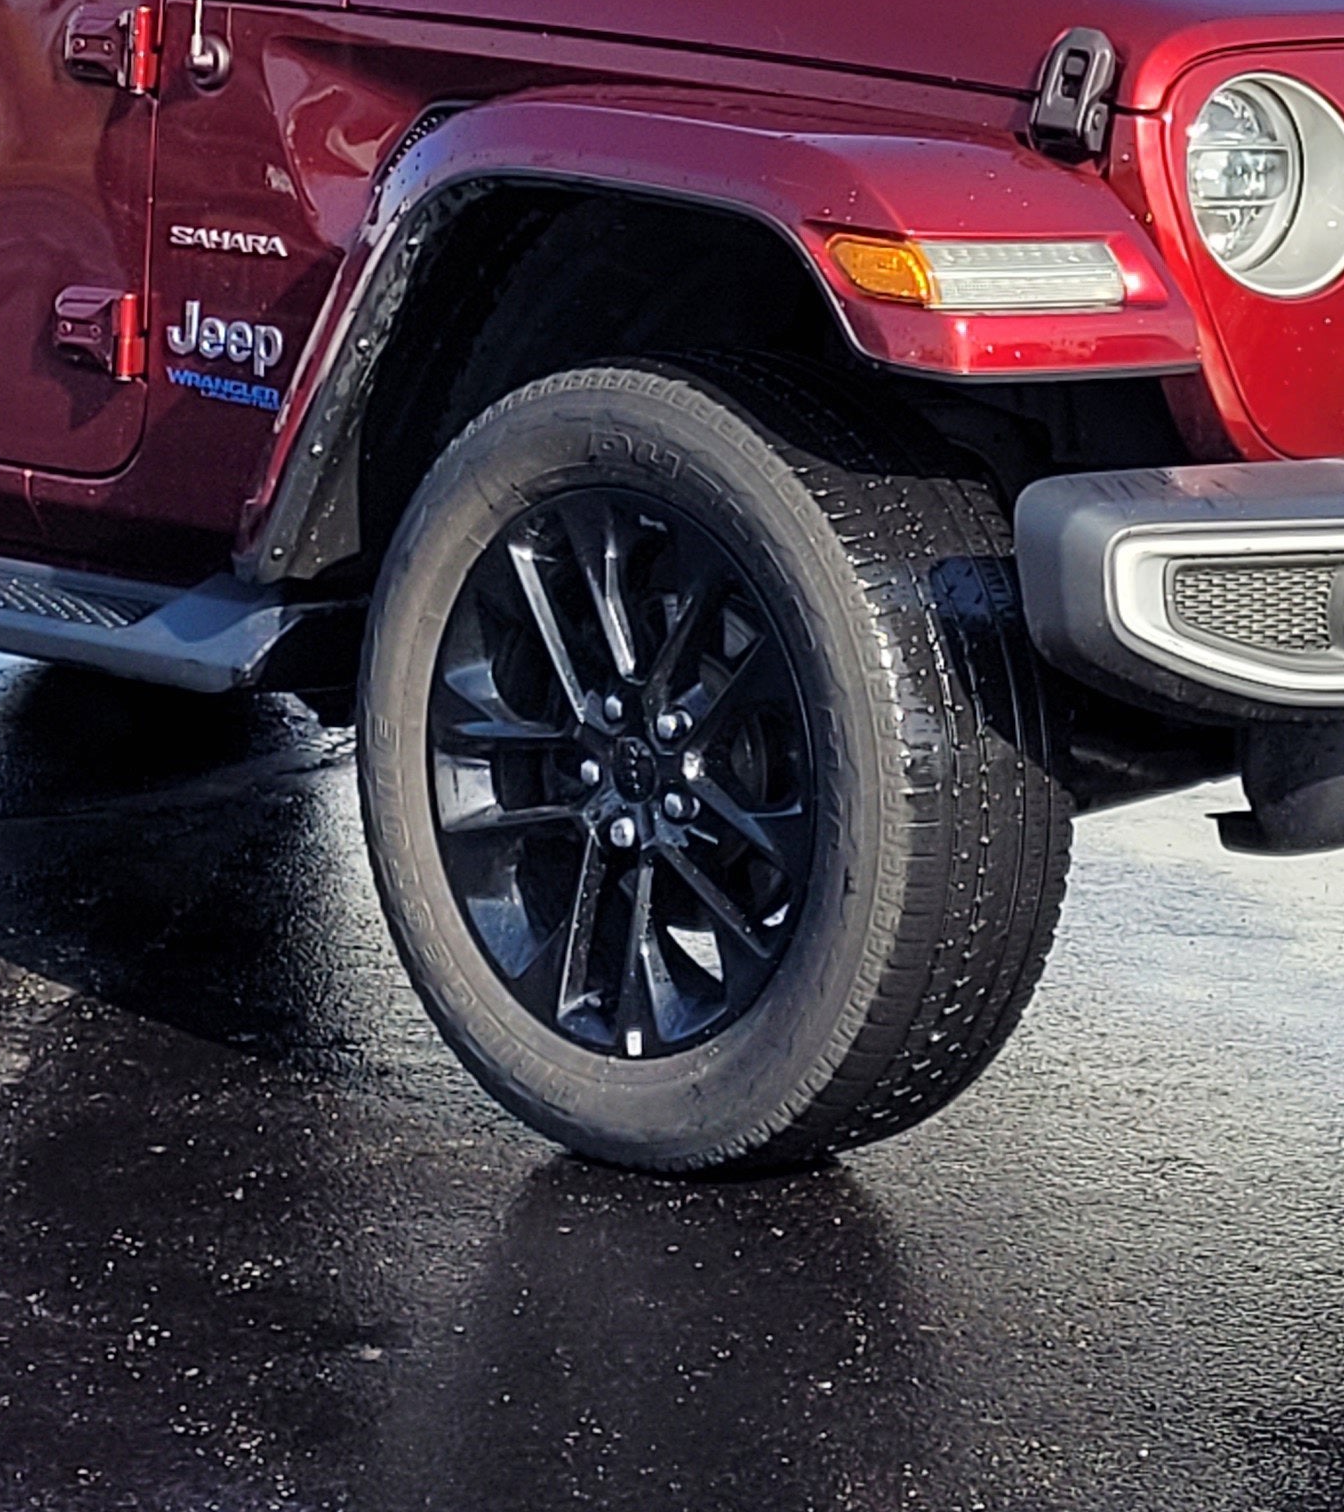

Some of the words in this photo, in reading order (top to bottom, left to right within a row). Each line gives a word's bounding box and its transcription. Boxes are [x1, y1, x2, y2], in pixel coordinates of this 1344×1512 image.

[170, 225, 288, 257] SAHARA
[166, 300, 283, 377] Jeep
[165, 366, 280, 404] WRANGLER
